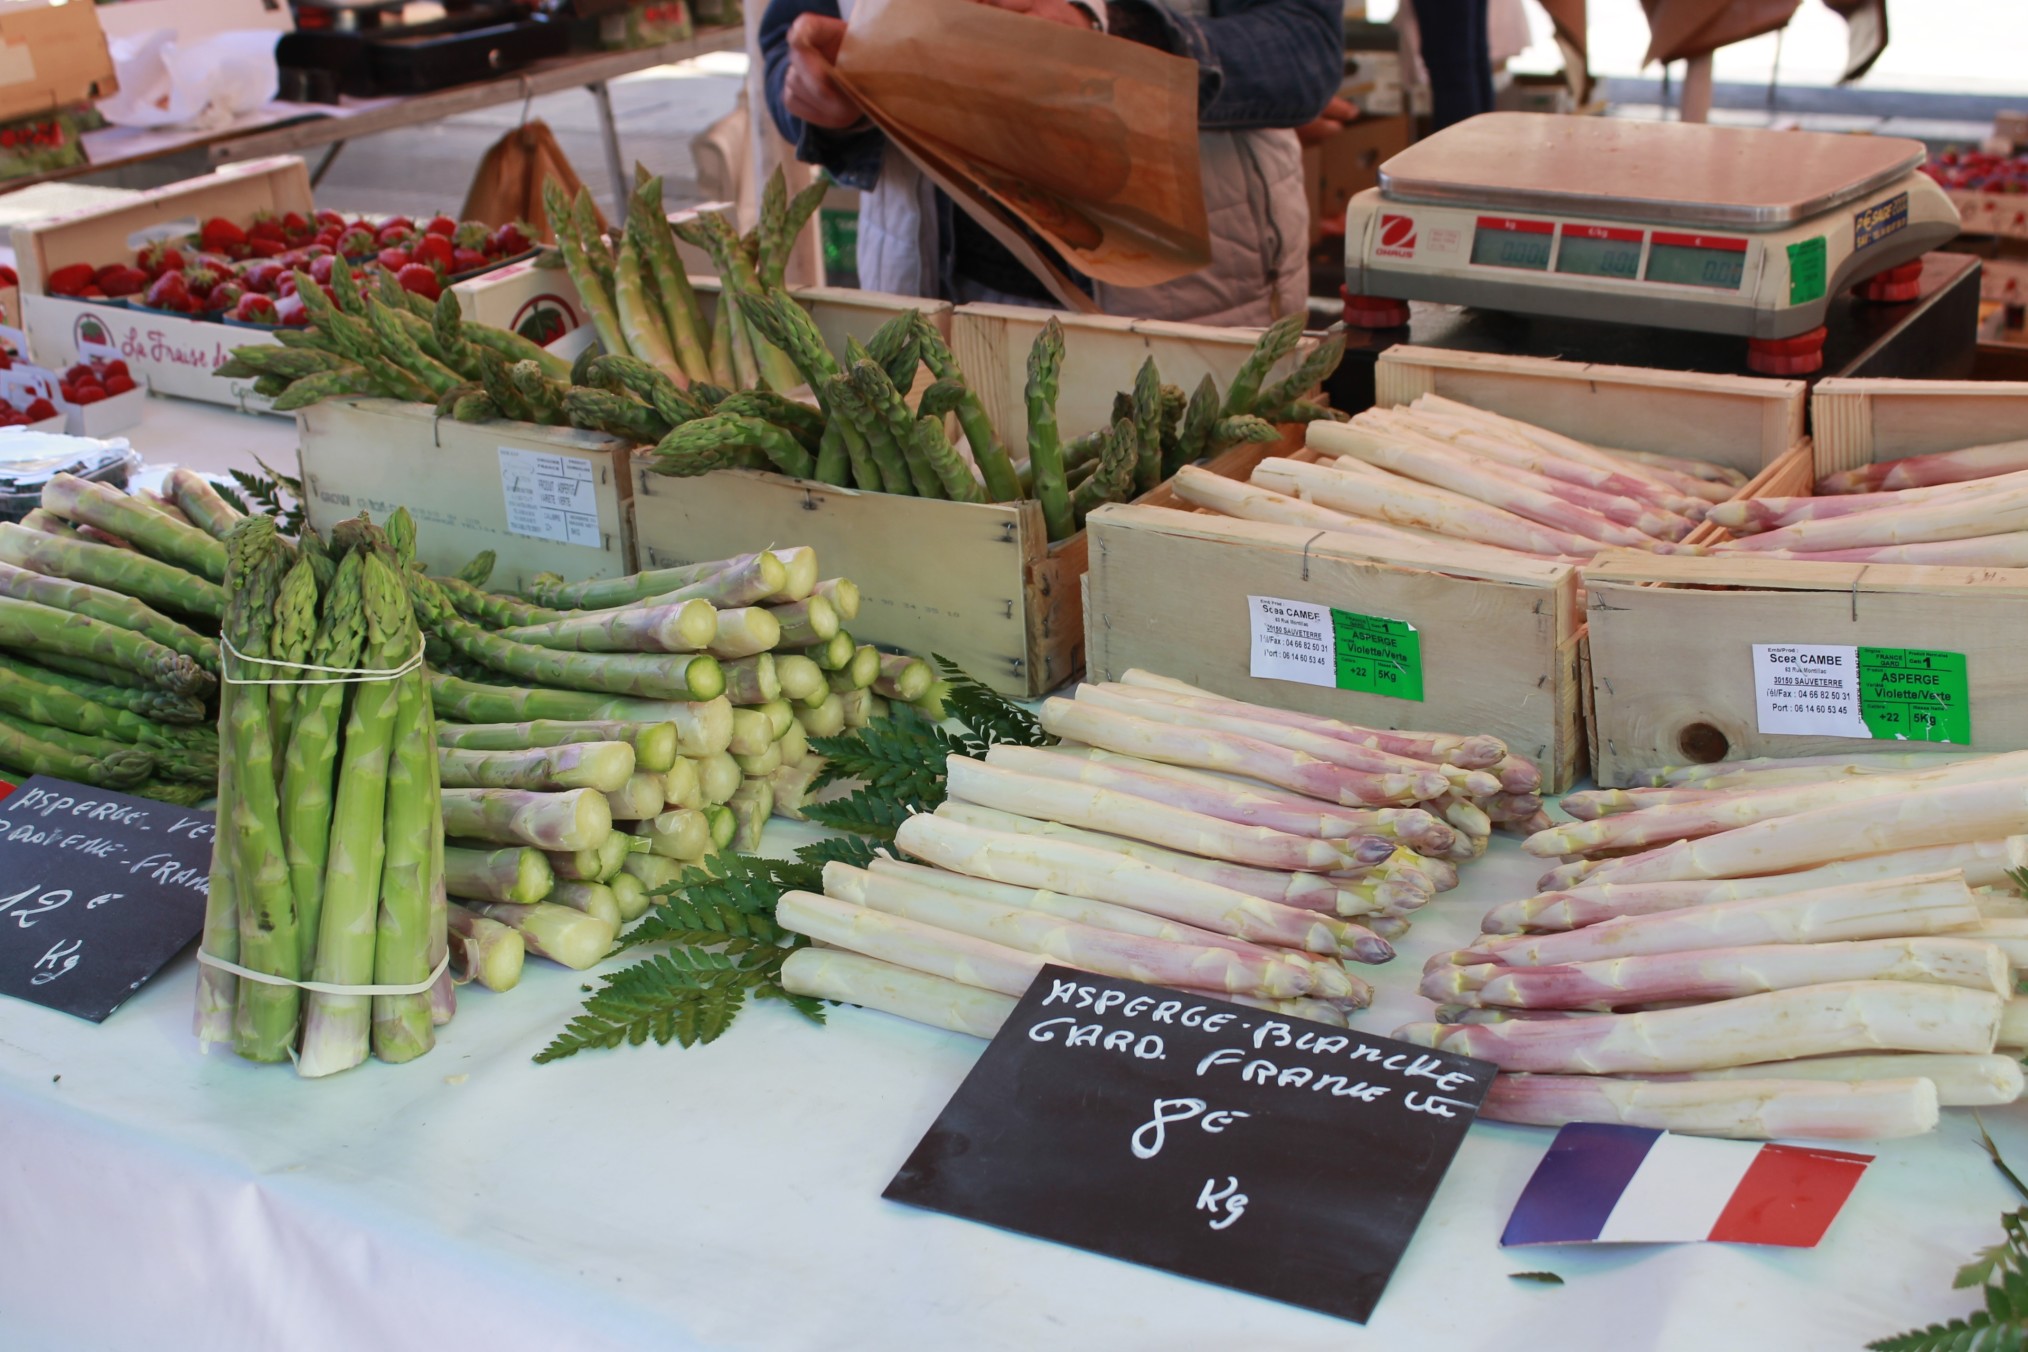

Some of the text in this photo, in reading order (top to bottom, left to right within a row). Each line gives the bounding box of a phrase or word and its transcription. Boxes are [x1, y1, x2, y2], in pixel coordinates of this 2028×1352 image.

[1376, 248, 1413, 259] OHAUS
[1283, 626, 1322, 639] SAUVETERRE
[1382, 623, 1389, 633] 1
[1286, 638, 1293, 647] 04
[1304, 642, 1311, 650] 82
[1312, 643, 1320, 652] 50
[1352, 631, 1398, 648] ASPERGE
[1283, 651, 1290, 660] 06
[1292, 653, 1299, 661] 14
[1309, 656, 1316, 664] 53
[1317, 657, 1325, 666] 45
[1347, 643, 1408, 662] Violette/Verte
[1769, 653, 1842, 666] Scea CAMBE
[1923, 657, 1931, 668] 1
[1350, 667, 1397, 683] +22 5Kg
[1774, 676, 1842, 687] 30150 SAUVETERRE
[1881, 672, 1940, 685] ASPERGE
[1798, 690, 1807, 698] 04
[1809, 690, 1818, 699] 66
[1820, 691, 1829, 699] 82
[1831, 691, 1840, 700] 50
[1842, 692, 1850, 701] 31
[1875, 688, 1951, 701] Violette/Verte
[1772, 703, 1847, 715] Port 06 14 60 53 45
[1879, 712, 1937, 726] +22 5Kg
[167, 816, 216, 844] VE
[30, 938, 83, 986] Kg
[1195, 1176, 1249, 1230] Kg
